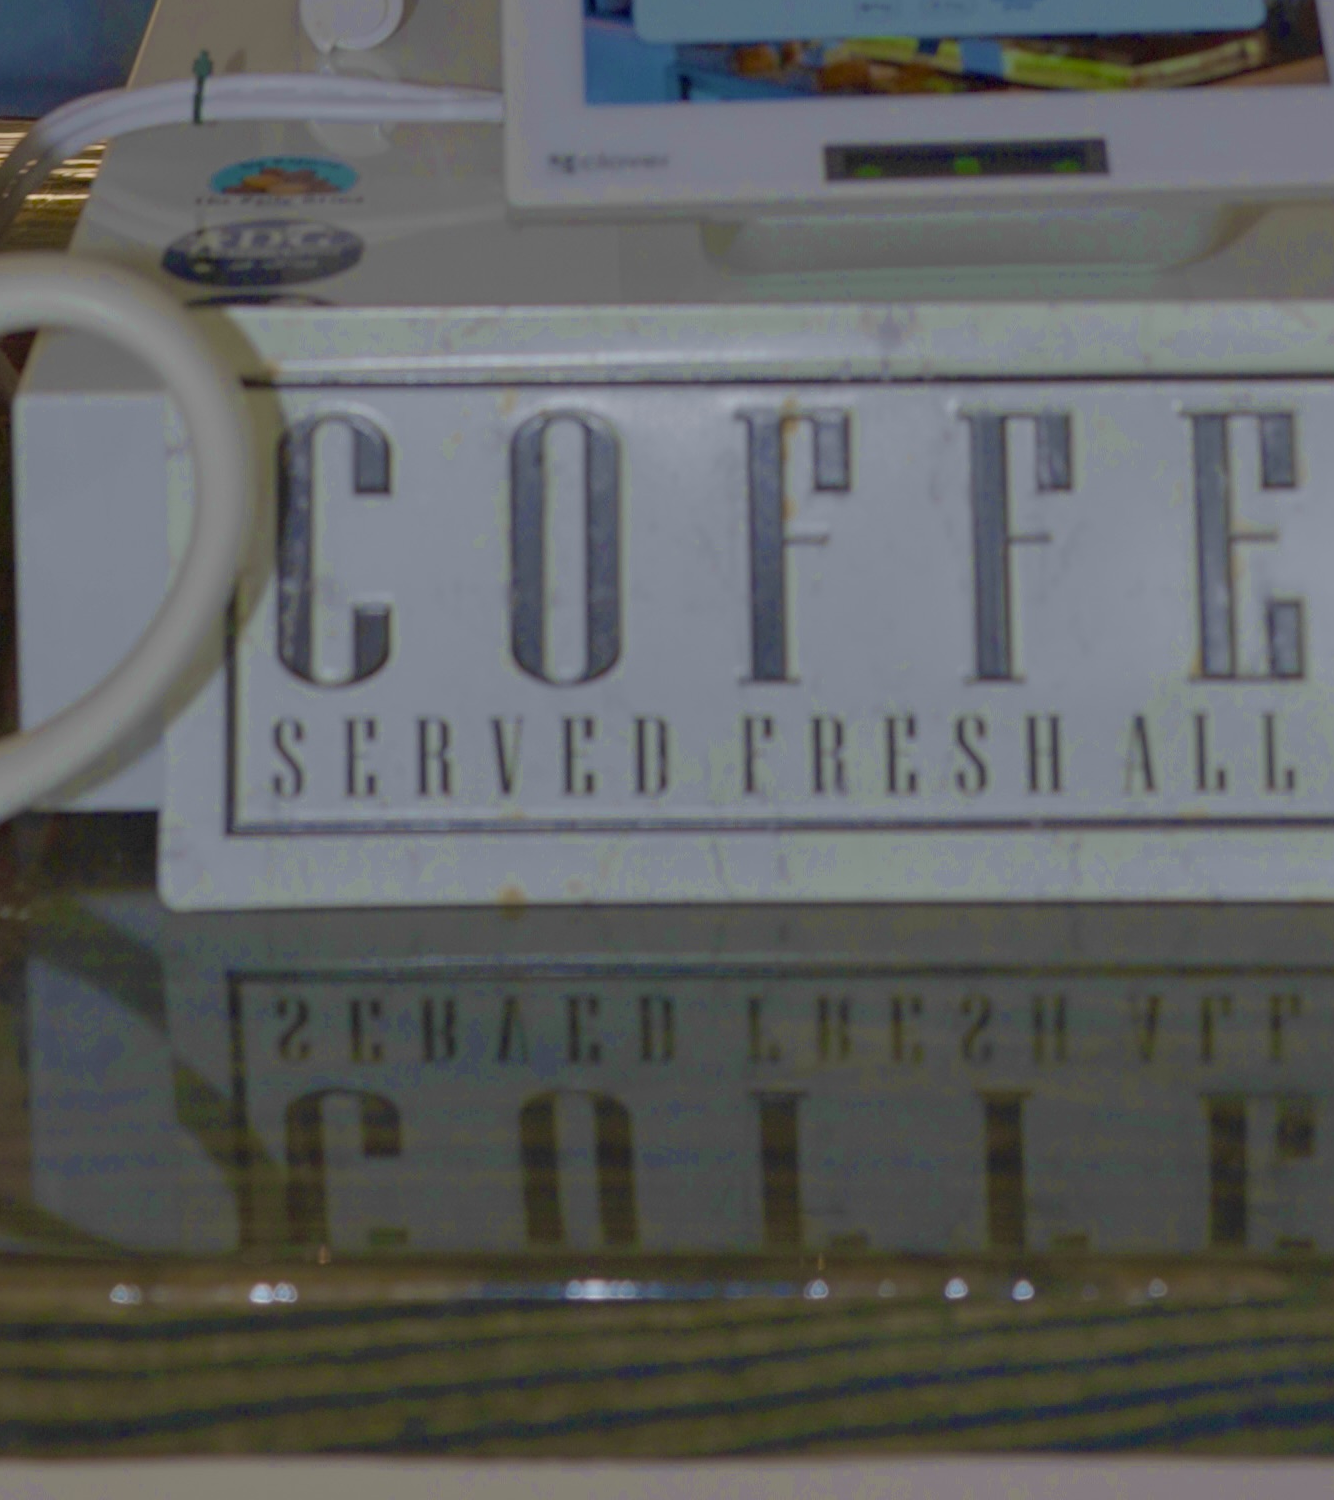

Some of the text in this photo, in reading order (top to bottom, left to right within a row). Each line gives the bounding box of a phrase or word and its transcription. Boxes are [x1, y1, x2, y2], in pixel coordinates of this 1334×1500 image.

[271, 713, 672, 802] SERVED
[742, 712, 1066, 797] FRESH
[1120, 712, 1300, 795] ALL
